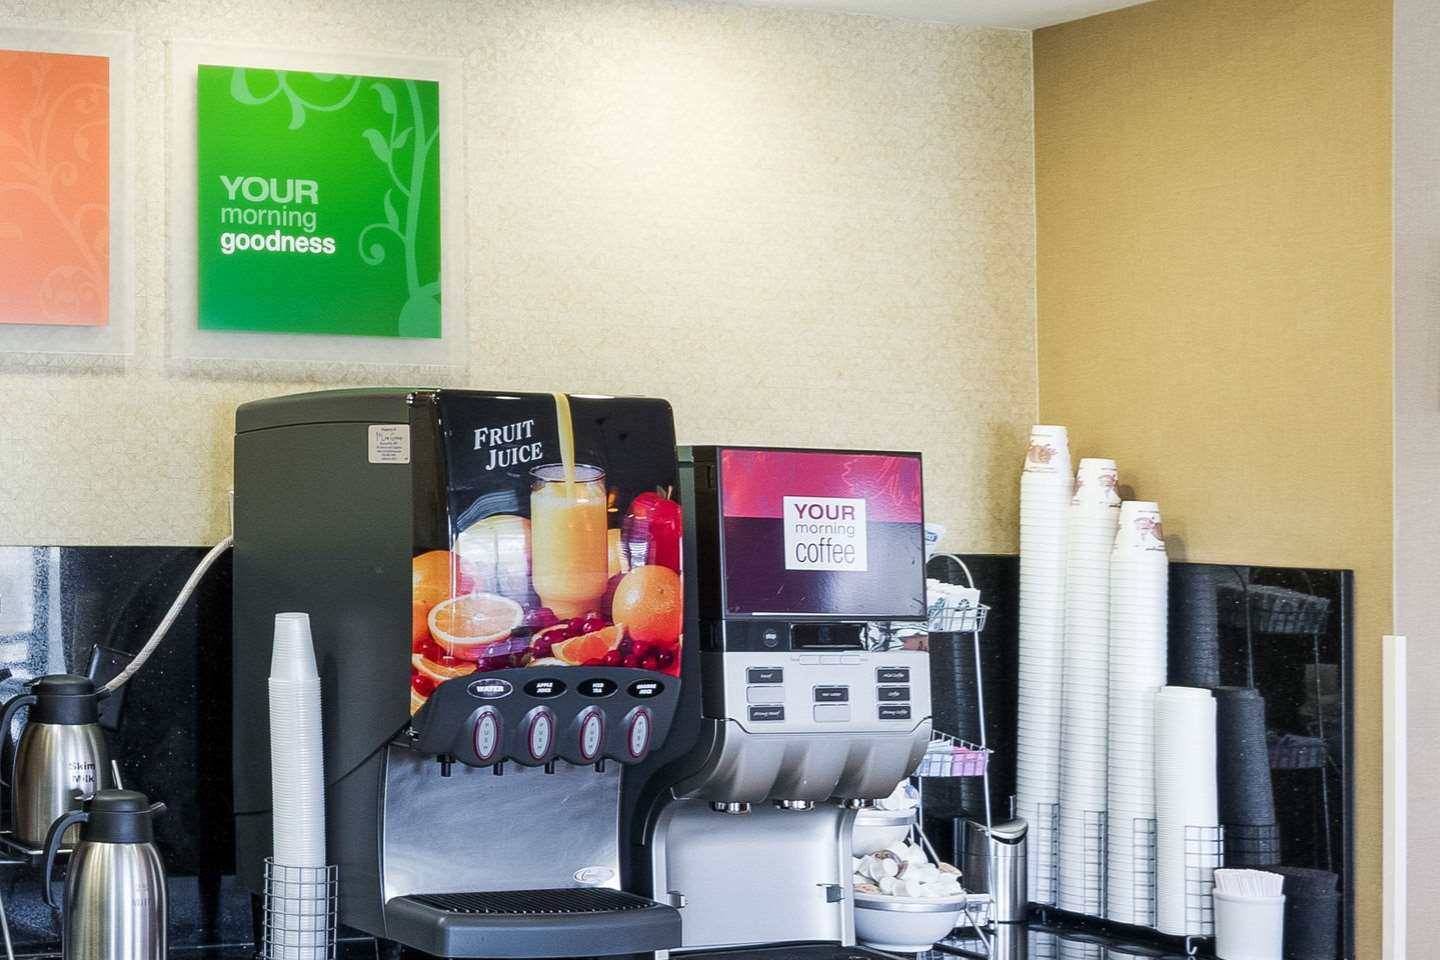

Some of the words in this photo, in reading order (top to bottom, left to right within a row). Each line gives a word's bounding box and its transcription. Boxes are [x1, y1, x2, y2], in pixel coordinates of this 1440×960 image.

[219, 175, 319, 205] YOUR
[220, 205, 317, 233] morning
[220, 229, 336, 255] goodness
[473, 419, 535, 450] FRUIT
[485, 442, 543, 471] JUICE
[794, 503, 856, 521] YOUR
[795, 522, 856, 538] morning
[795, 537, 856, 564] coffee
